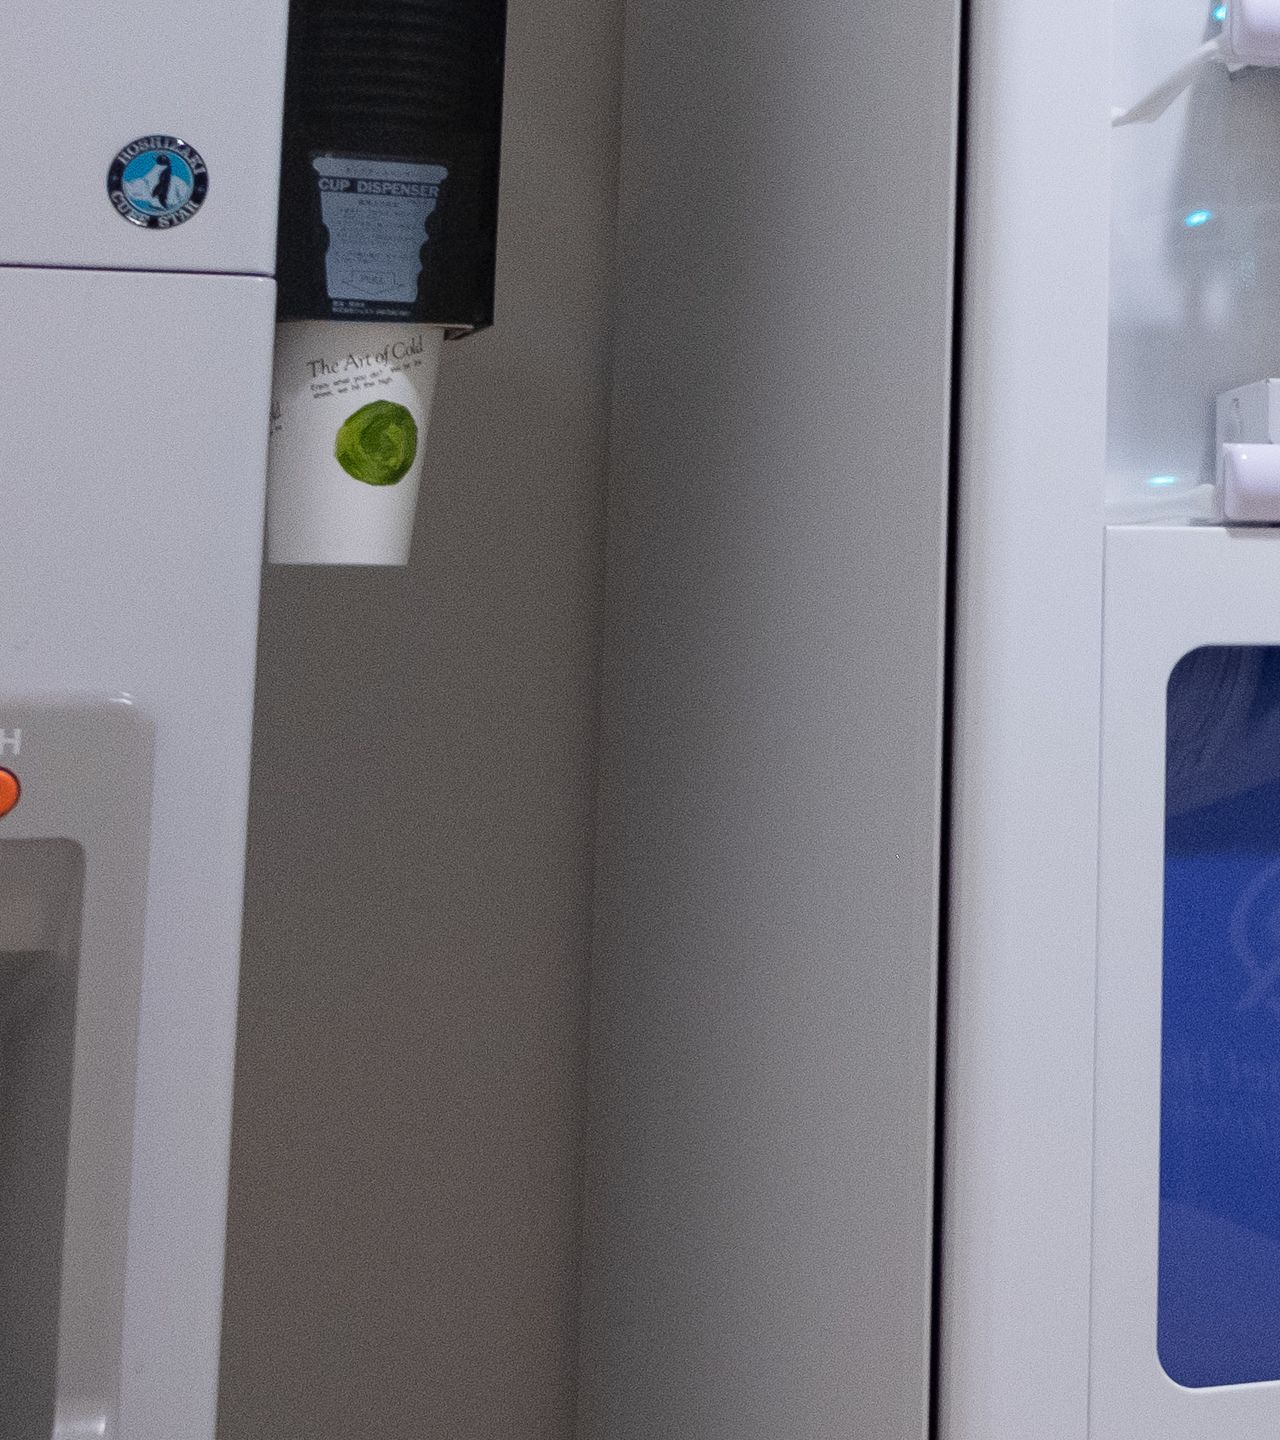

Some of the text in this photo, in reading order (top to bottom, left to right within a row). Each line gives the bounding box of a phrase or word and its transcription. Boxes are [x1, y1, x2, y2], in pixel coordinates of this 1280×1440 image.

[318, 177, 440, 199] CUP DISPENSER
[306, 335, 424, 379] The Art of Cold
